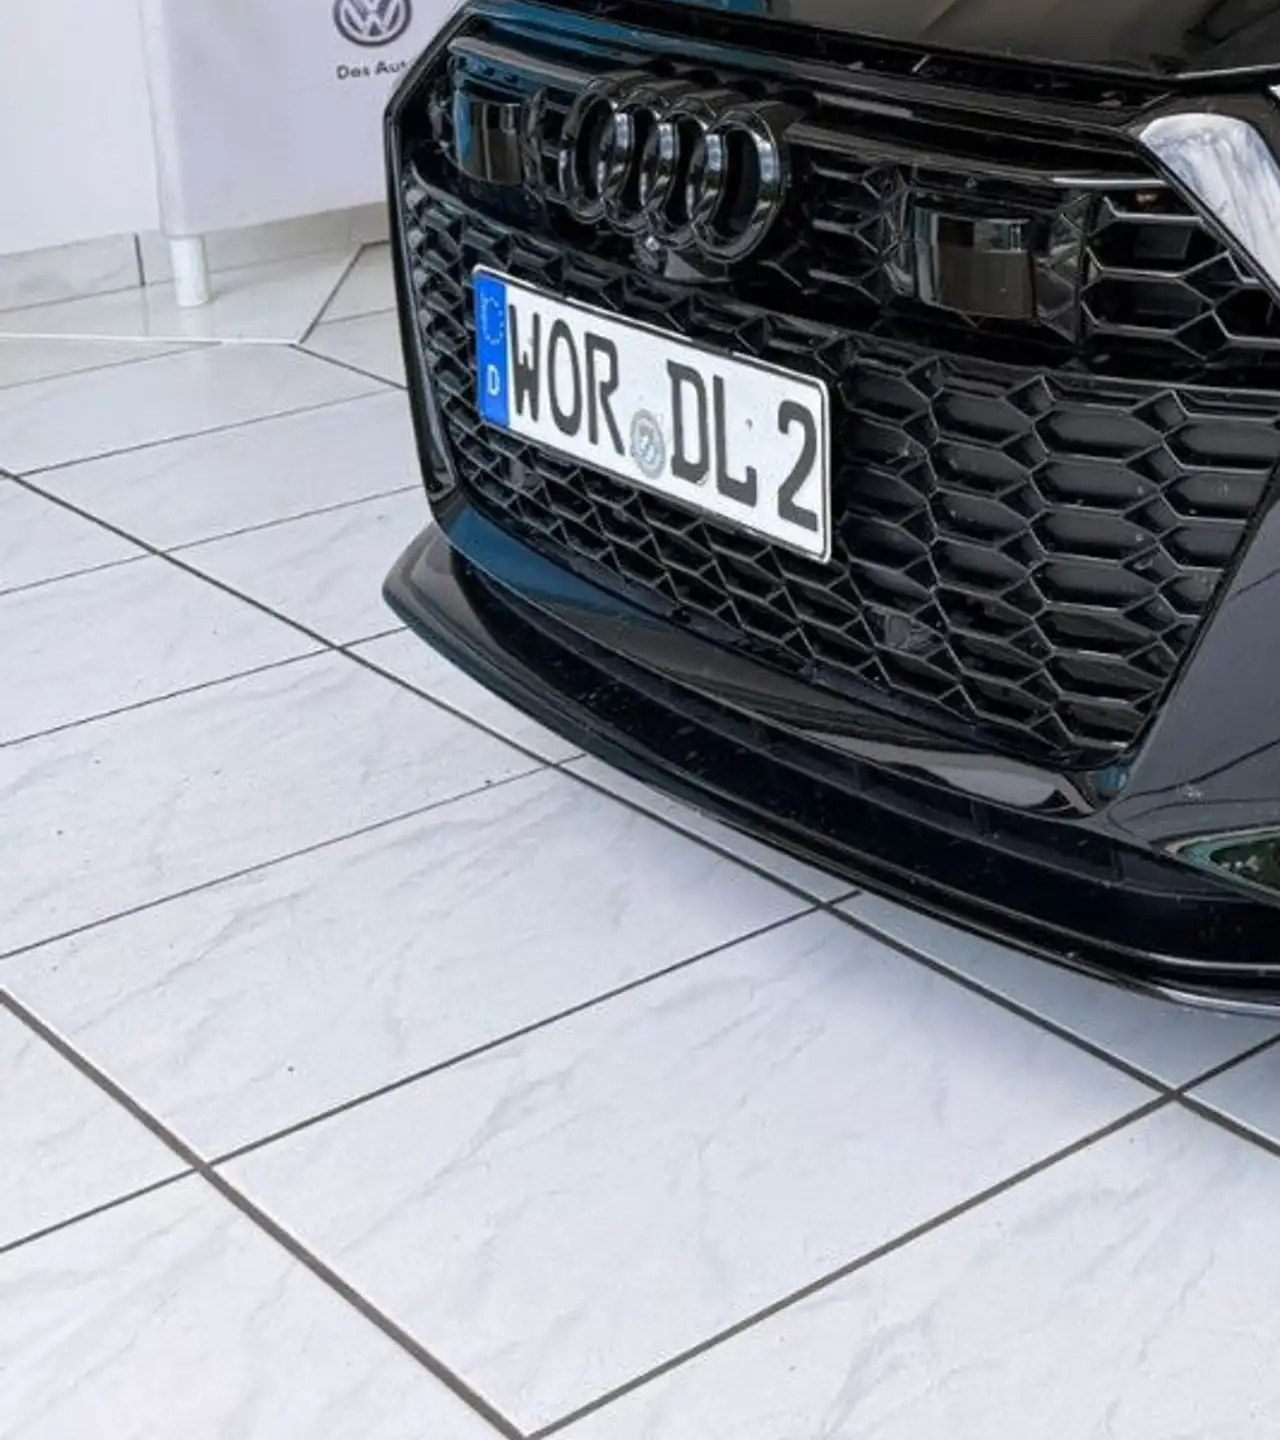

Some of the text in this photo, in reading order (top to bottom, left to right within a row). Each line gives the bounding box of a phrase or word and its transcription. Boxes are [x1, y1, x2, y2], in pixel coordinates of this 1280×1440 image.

[336, 63, 370, 81] Das
[486, 363, 501, 396] D
[508, 304, 625, 455] WOR
[666, 358, 758, 508] DL
[777, 400, 819, 532] 2
